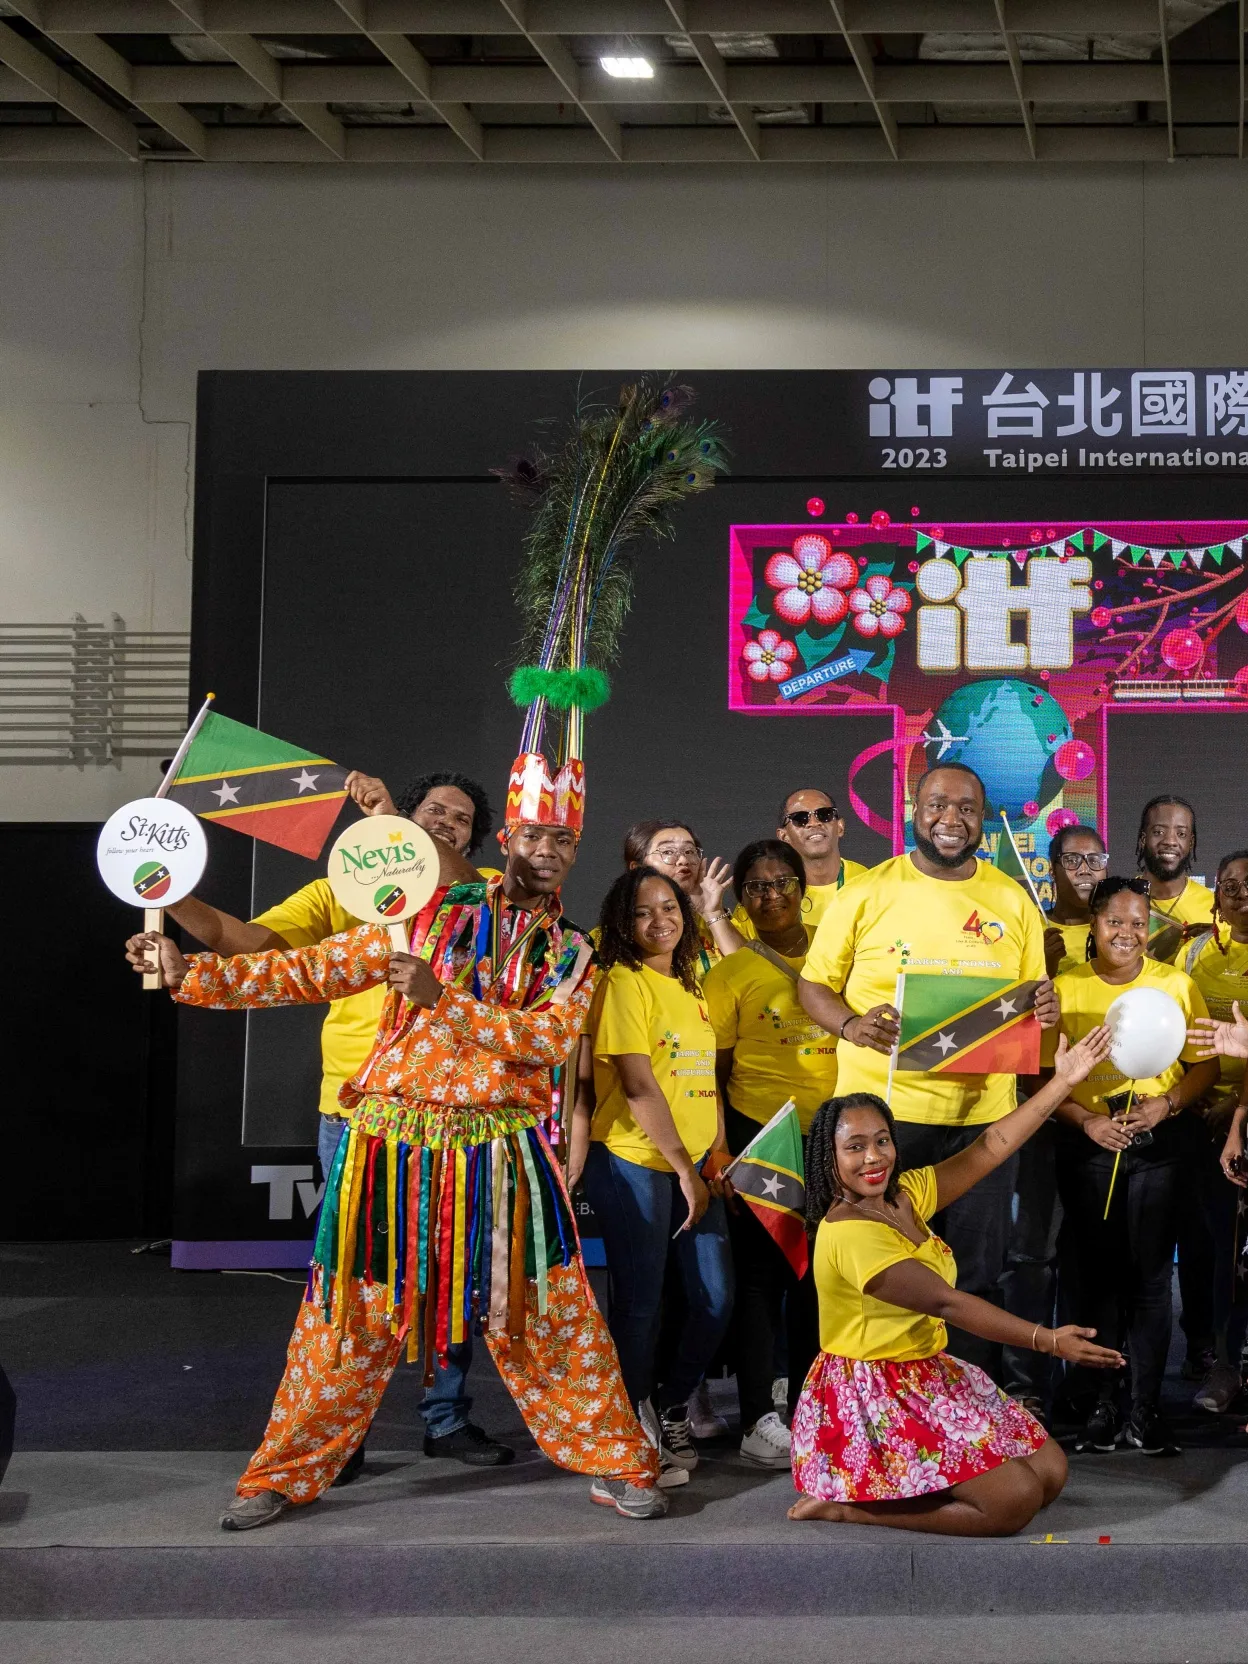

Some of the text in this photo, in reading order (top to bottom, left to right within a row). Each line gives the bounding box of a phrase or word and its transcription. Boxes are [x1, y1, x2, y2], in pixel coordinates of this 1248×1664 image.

[881, 448, 947, 469] 2023
[983, 449, 1068, 472] Taipei
[782, 657, 857, 696] DEPARTURE
[147, 823, 190, 852] Kitts
[338, 842, 416, 874] Nevis
[901, 958, 1001, 968] SHARING KINDNESS
